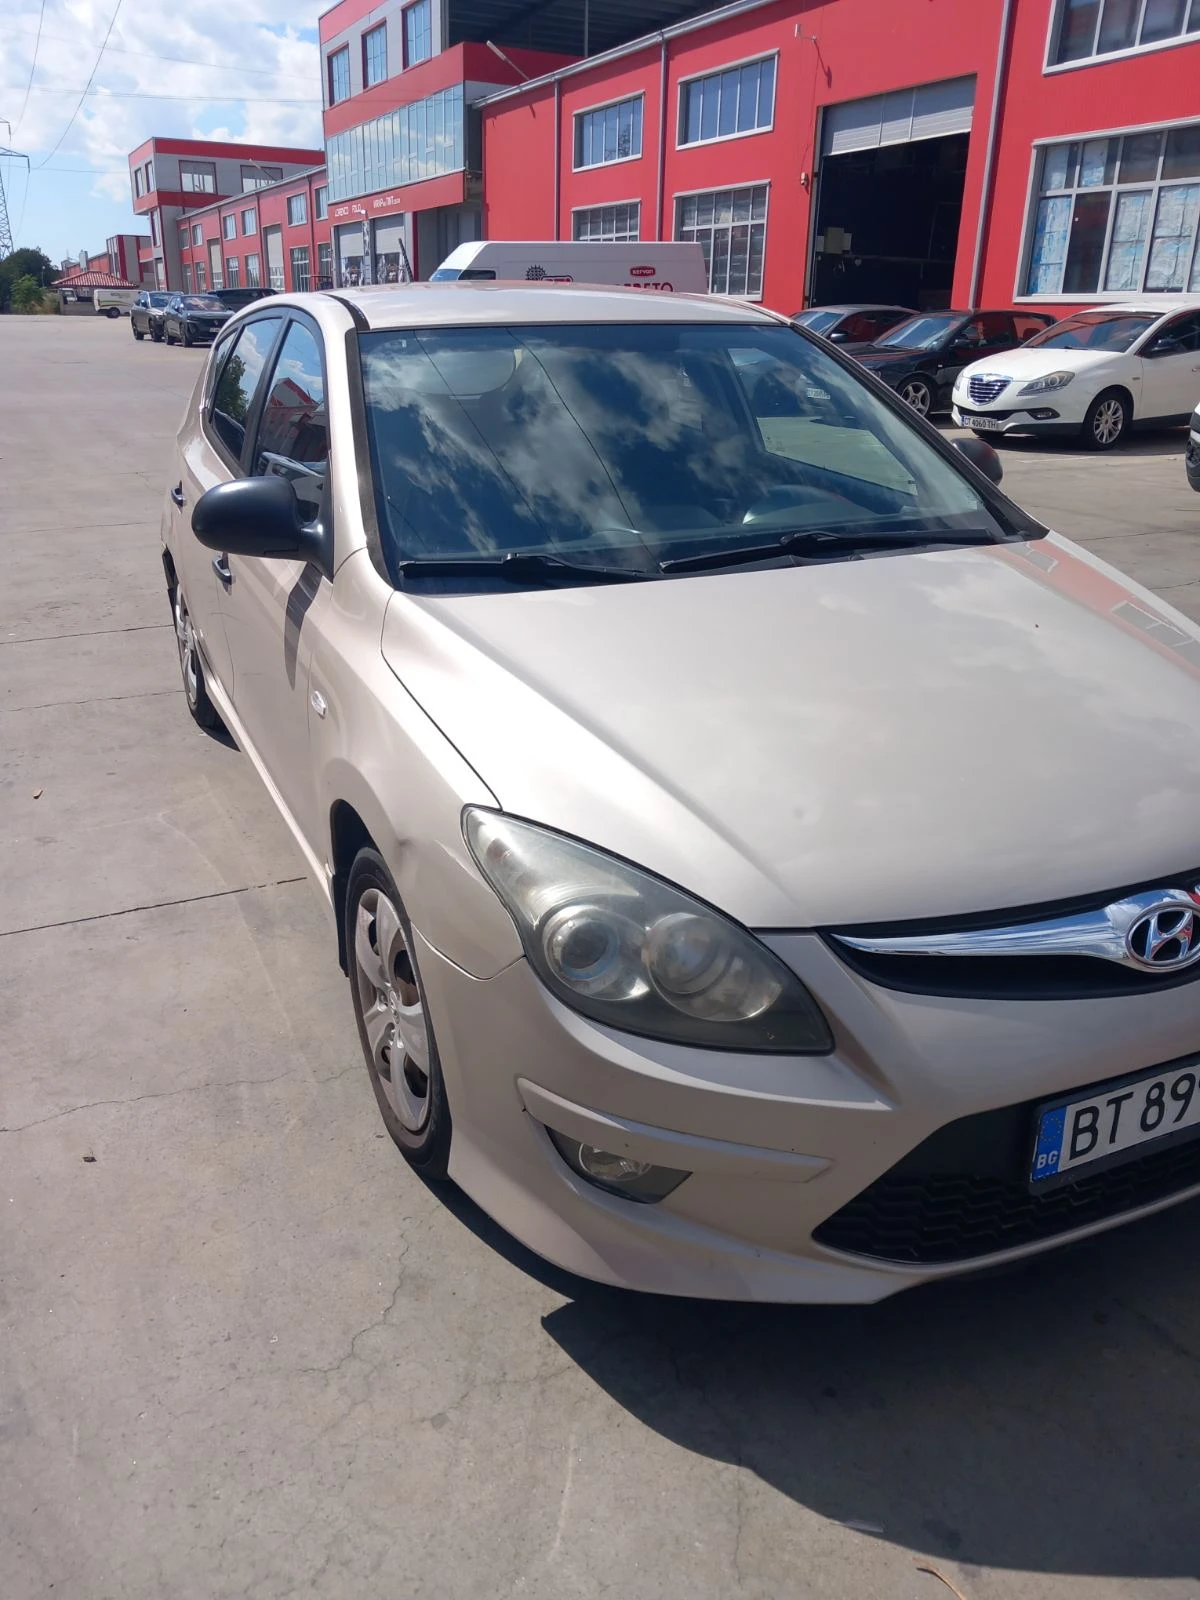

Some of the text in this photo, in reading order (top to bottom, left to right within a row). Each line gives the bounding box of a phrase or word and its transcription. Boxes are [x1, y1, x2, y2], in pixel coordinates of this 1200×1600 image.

[1069, 1073, 1200, 1161] BT 89
[1036, 1150, 1058, 1169] BG
